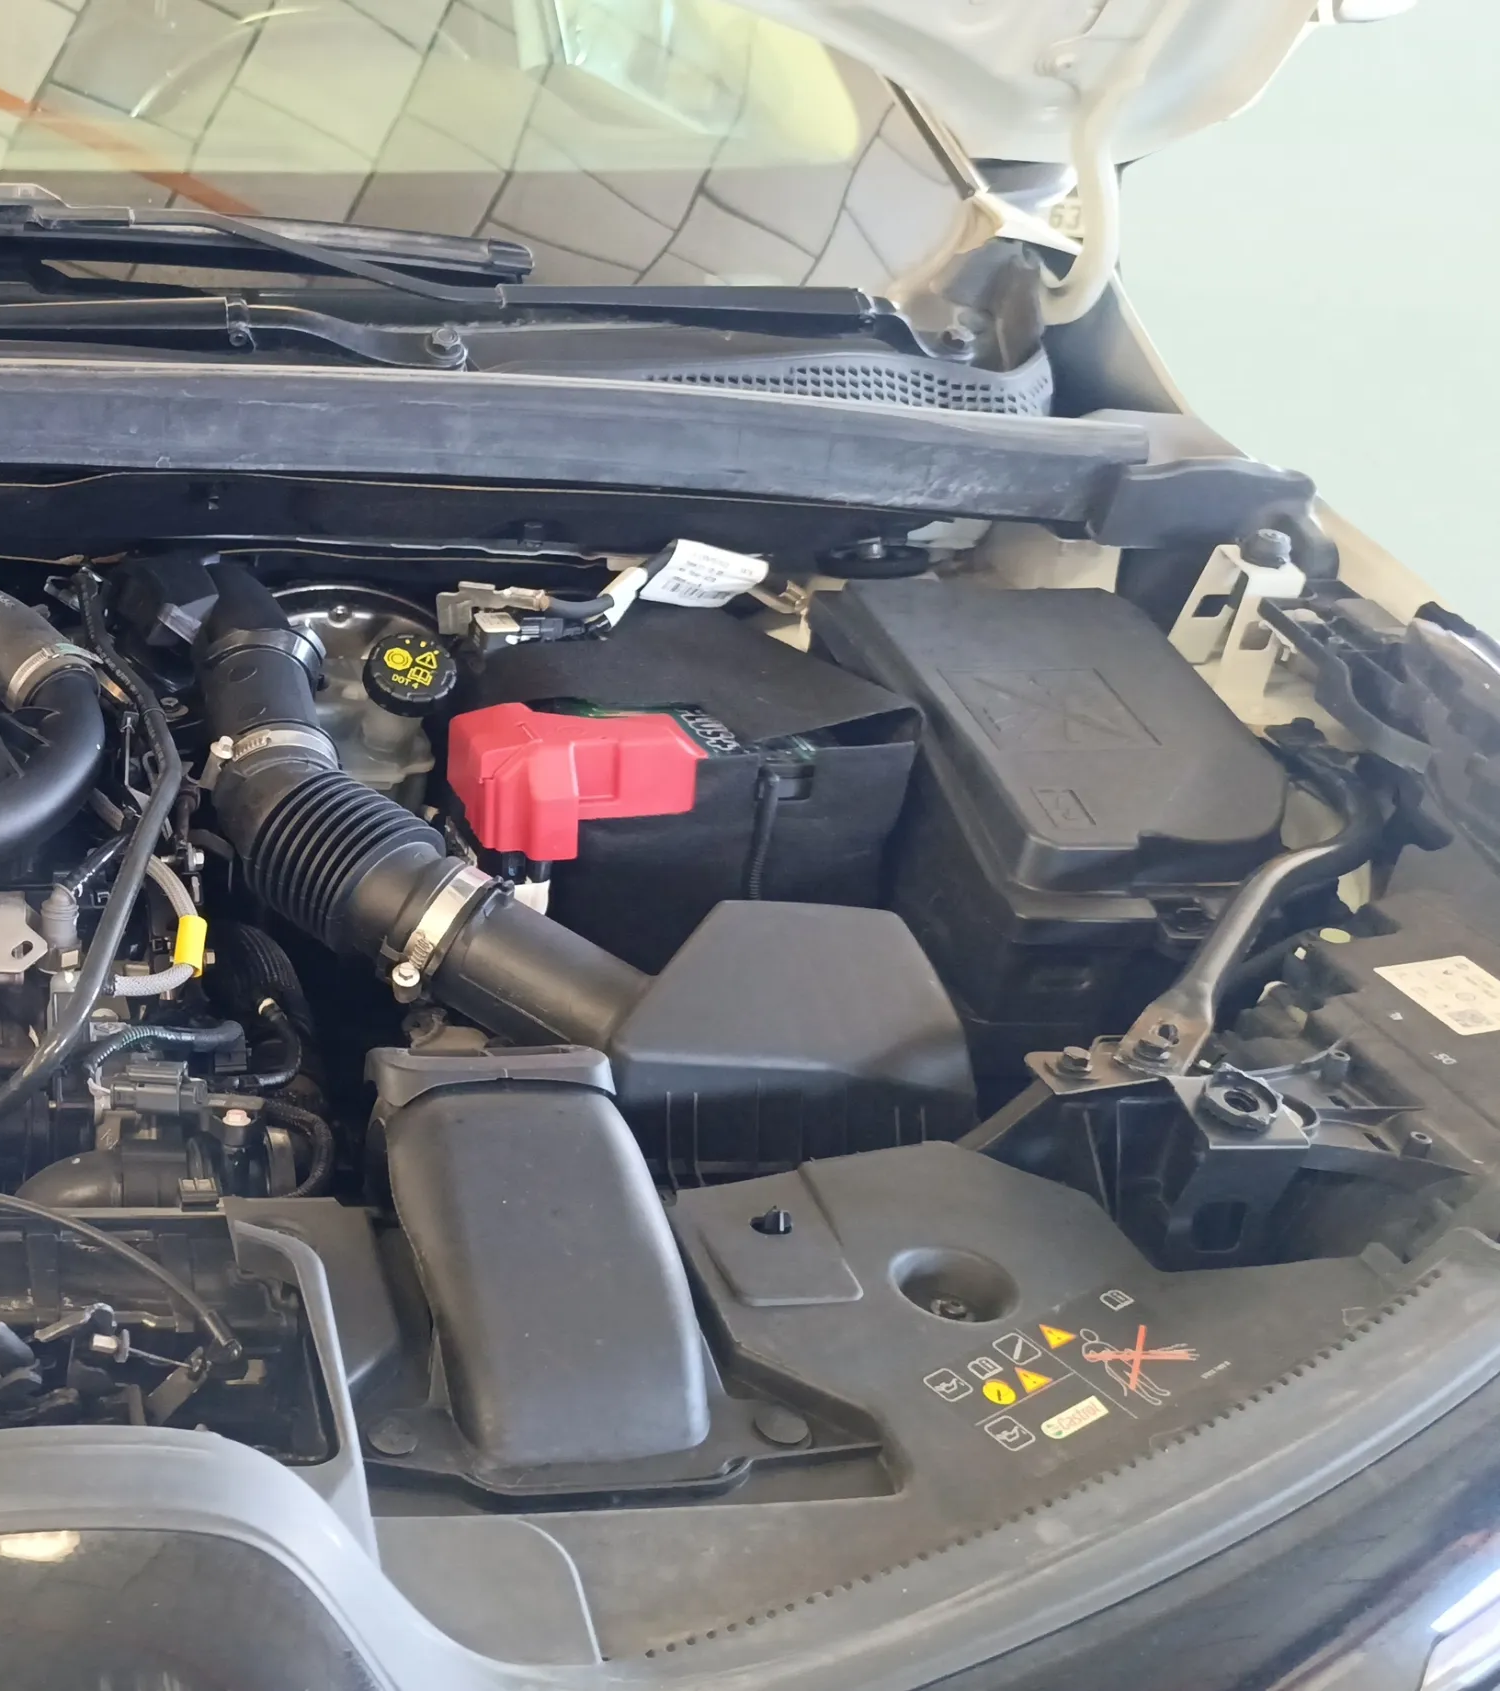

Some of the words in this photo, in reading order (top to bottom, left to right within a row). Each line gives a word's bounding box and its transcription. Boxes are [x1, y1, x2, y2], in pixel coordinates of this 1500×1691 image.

[391, 673, 411, 687] DOT
[412, 681, 419, 690] 4
[1057, 1401, 1102, 1430] Castrol
